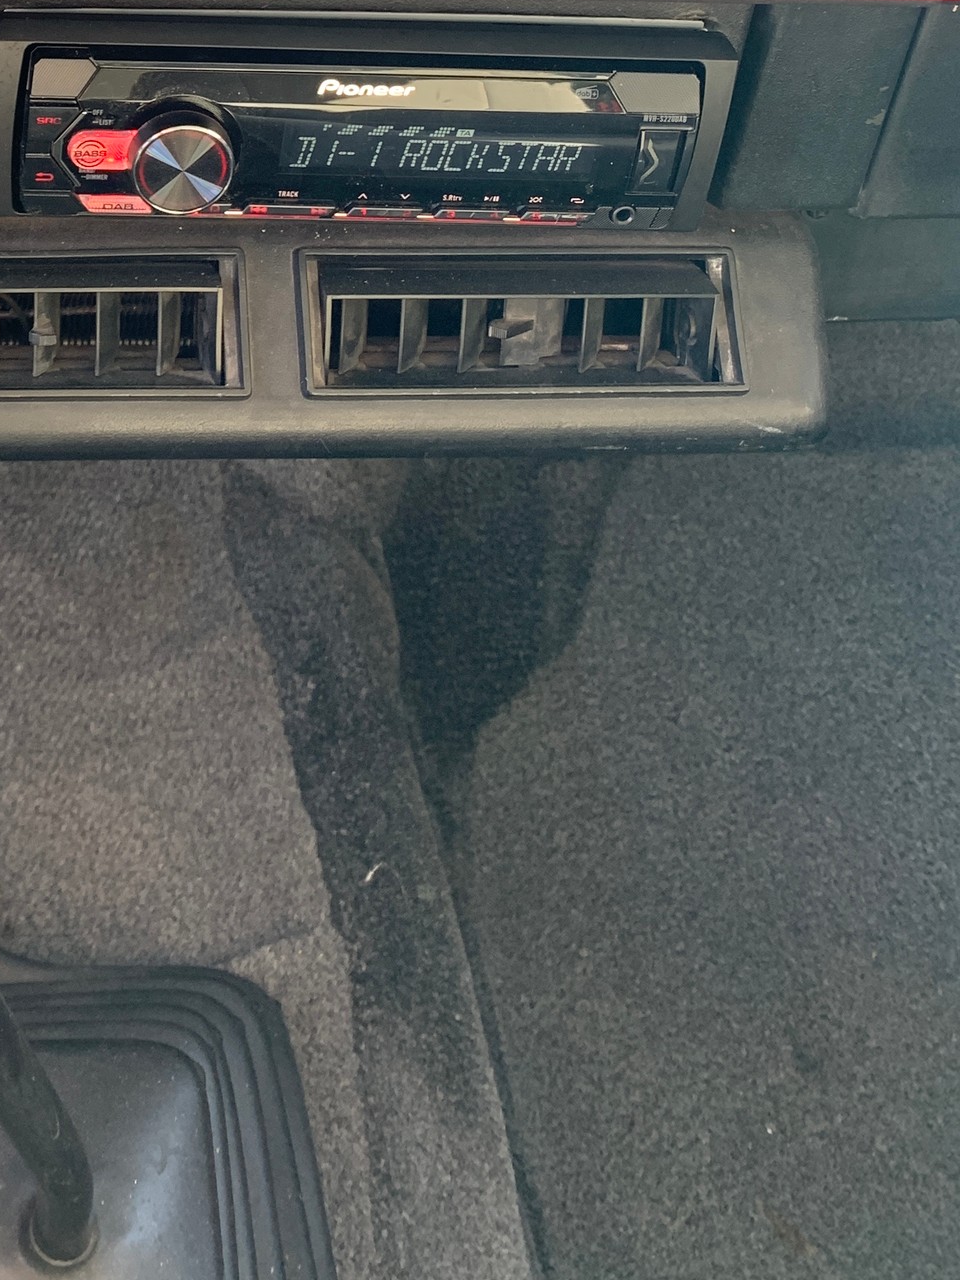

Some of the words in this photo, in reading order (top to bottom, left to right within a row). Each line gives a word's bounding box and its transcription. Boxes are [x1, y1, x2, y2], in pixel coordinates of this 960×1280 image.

[317, 79, 416, 96] Pioneer
[36, 117, 62, 125] SRC
[74, 150, 107, 158] BASS
[399, 139, 583, 172] ROCKSTAR
[278, 190, 299, 198] TRACK
